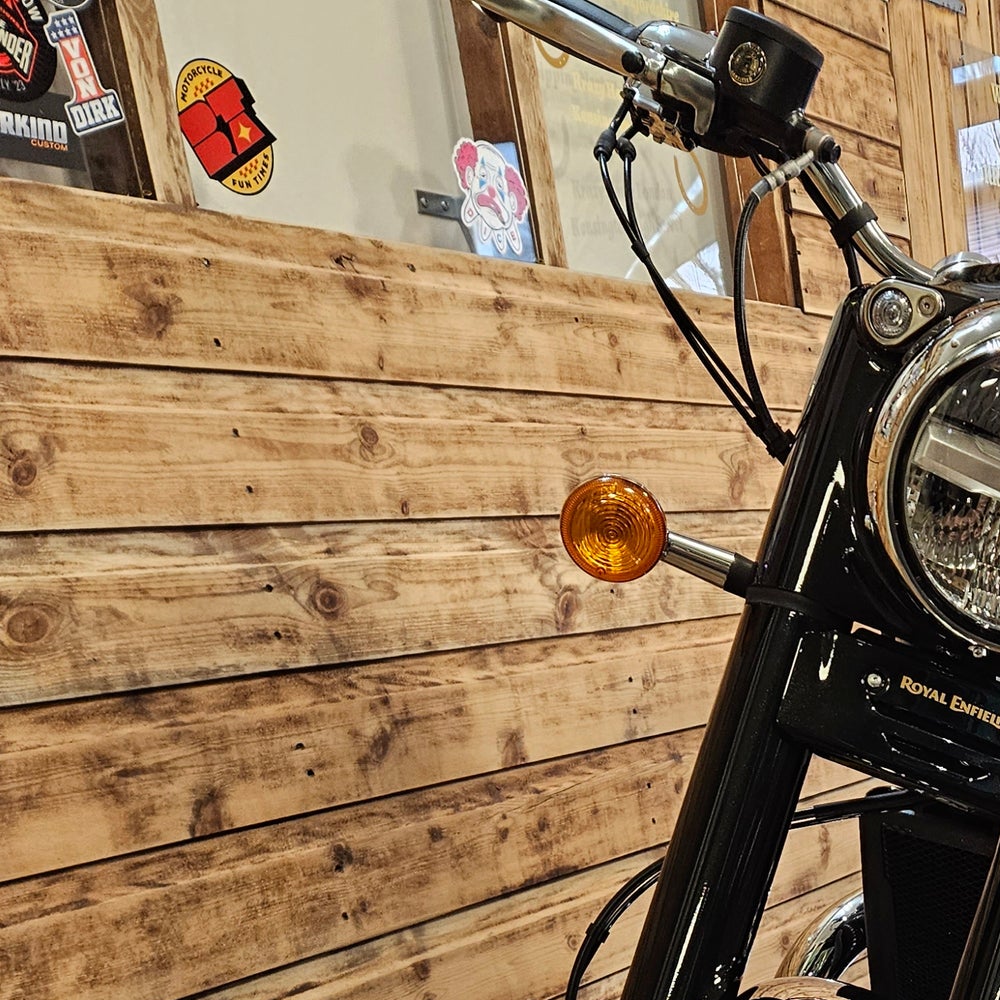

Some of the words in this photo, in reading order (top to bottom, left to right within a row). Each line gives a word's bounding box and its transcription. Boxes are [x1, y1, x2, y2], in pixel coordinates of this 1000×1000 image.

[62, 36, 97, 99] VON
[181, 66, 223, 102] MOTORCYCLE
[70, 94, 120, 130] DIRK
[30, 139, 69, 151] CUSTOM
[232, 178, 252, 189] FUN
[253, 152, 269, 185] TIMES
[900, 675, 948, 705] ROYAL
